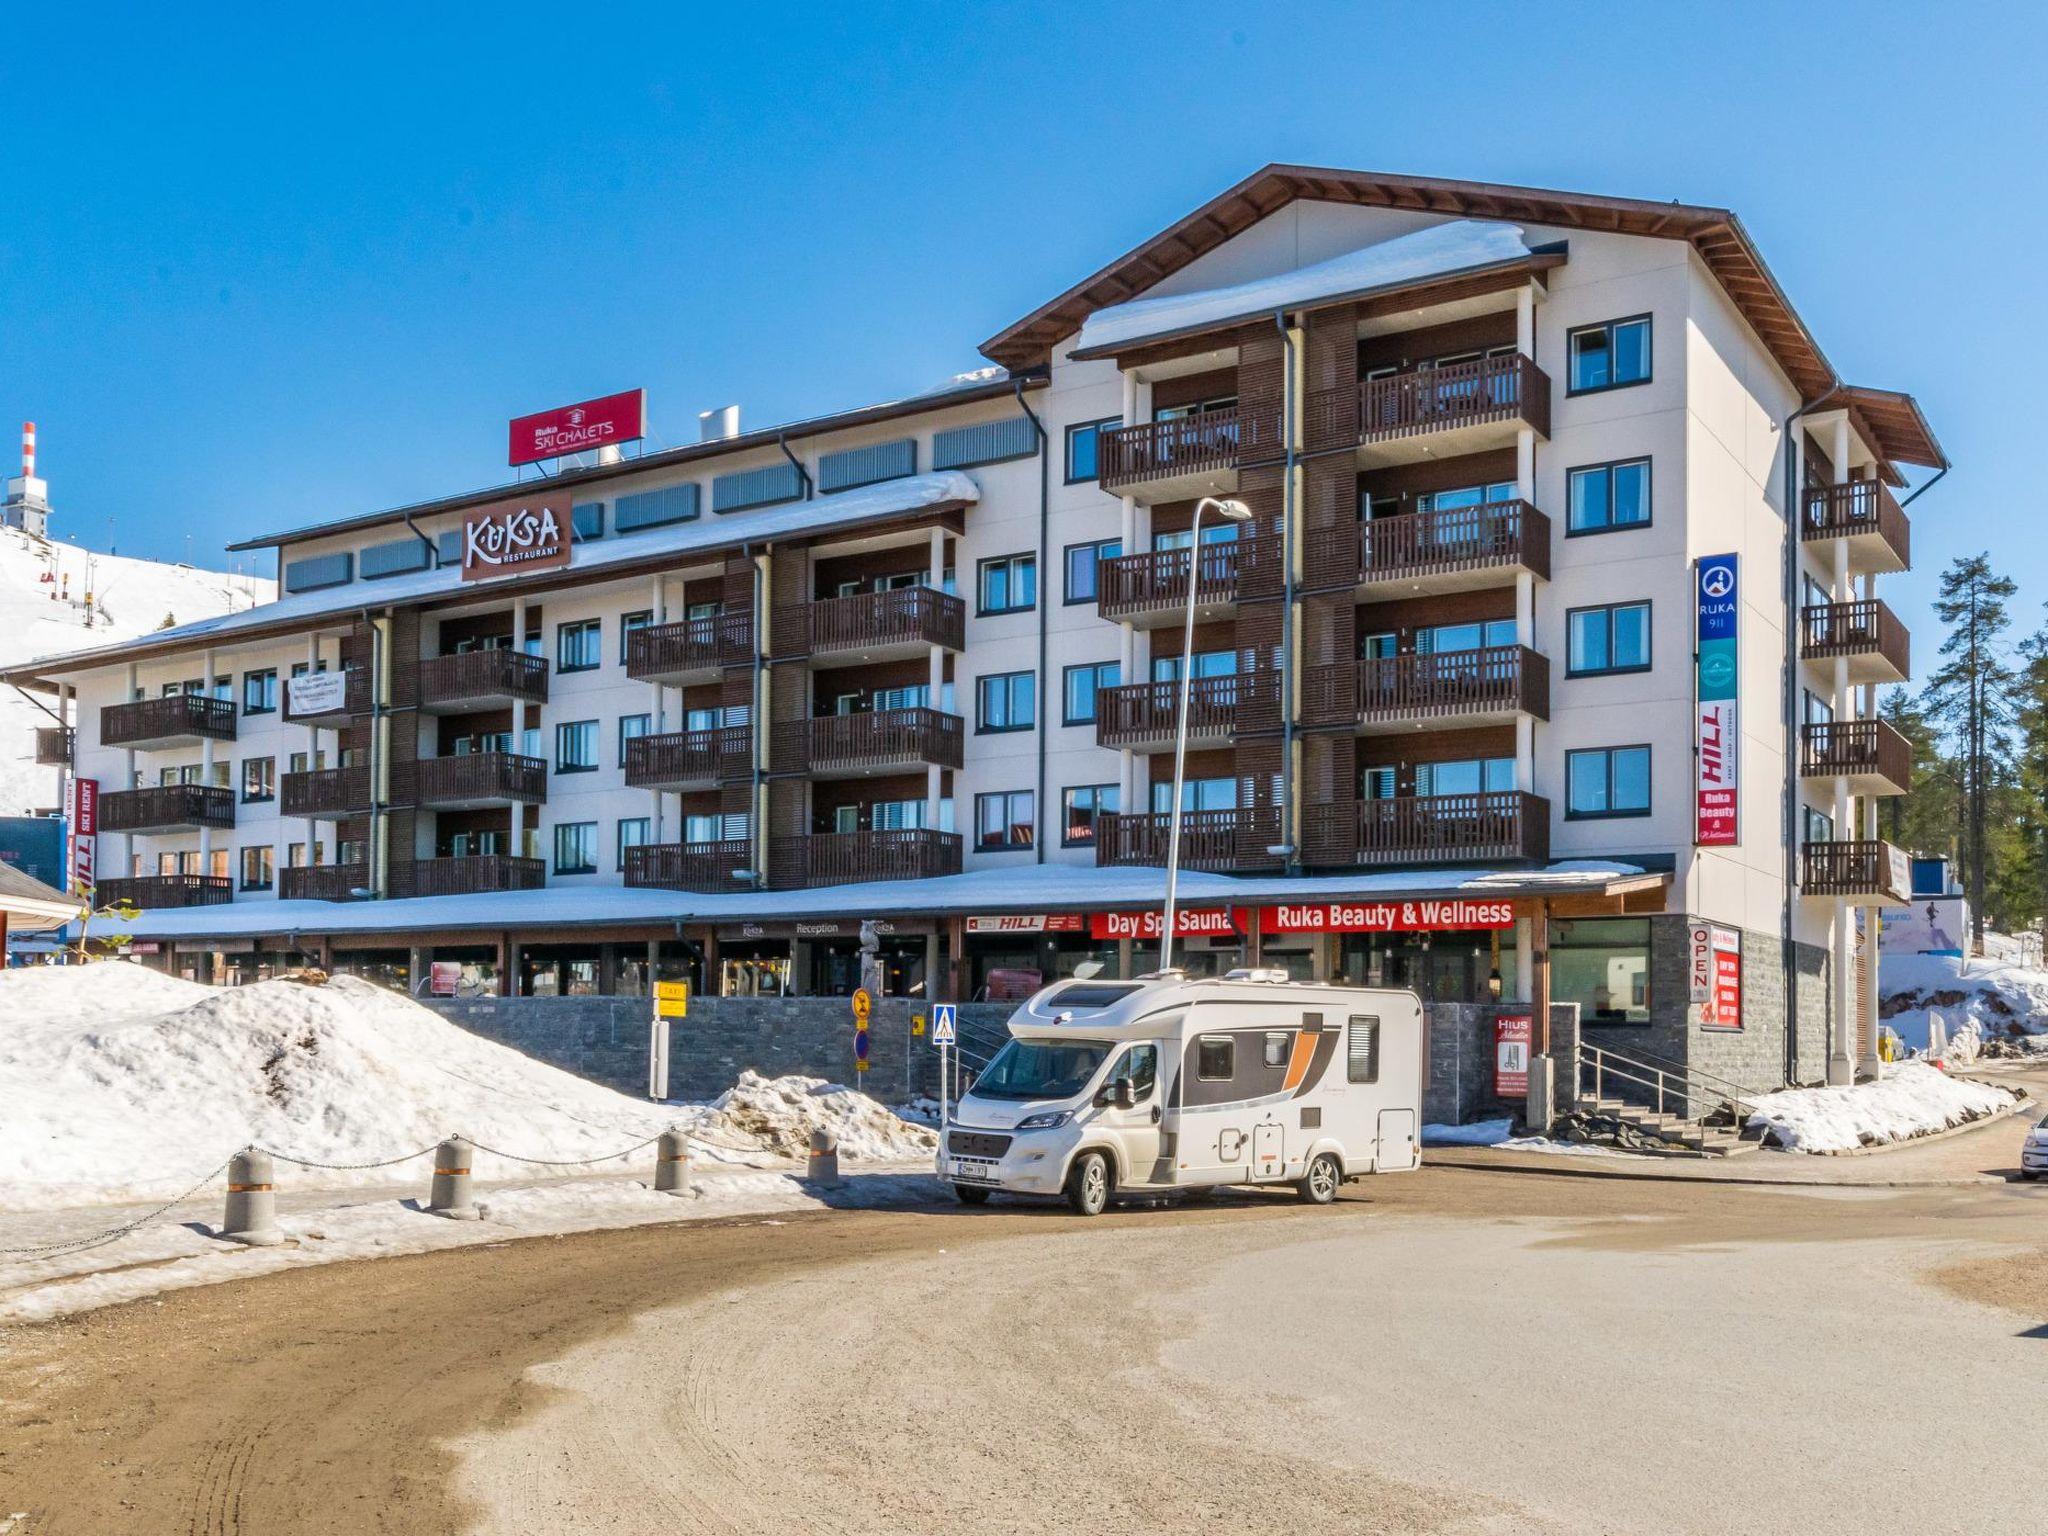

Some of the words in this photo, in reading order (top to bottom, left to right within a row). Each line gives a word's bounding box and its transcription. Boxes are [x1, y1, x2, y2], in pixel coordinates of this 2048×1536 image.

[535, 426, 558, 437] Ruka
[535, 438, 554, 450] SKI
[556, 421, 614, 445] CHALETS
[503, 546, 558, 563] RESTAURANT
[1700, 603, 1735, 615] RUKA
[1709, 618, 1724, 629] 911
[1702, 706, 1721, 783] HILL
[82, 782, 92, 812] RENT
[1705, 793, 1730, 804] Ruka
[1700, 806, 1735, 818] Beauty
[82, 813, 91, 832] SKI
[1712, 820, 1720, 829] &
[1000, 917, 1039, 929] HILL
[1277, 906, 1324, 927] Ruka
[1329, 904, 1396, 930] Beauty
[1402, 902, 1417, 924] &
[1421, 902, 1512, 925] Wellness
[796, 923, 839, 935] Reception
[1108, 913, 1139, 937] Day
[1144, 912, 1174, 936] Sp
[1179, 910, 1232, 931] Sauna
[1694, 930, 1707, 986] OPEN
